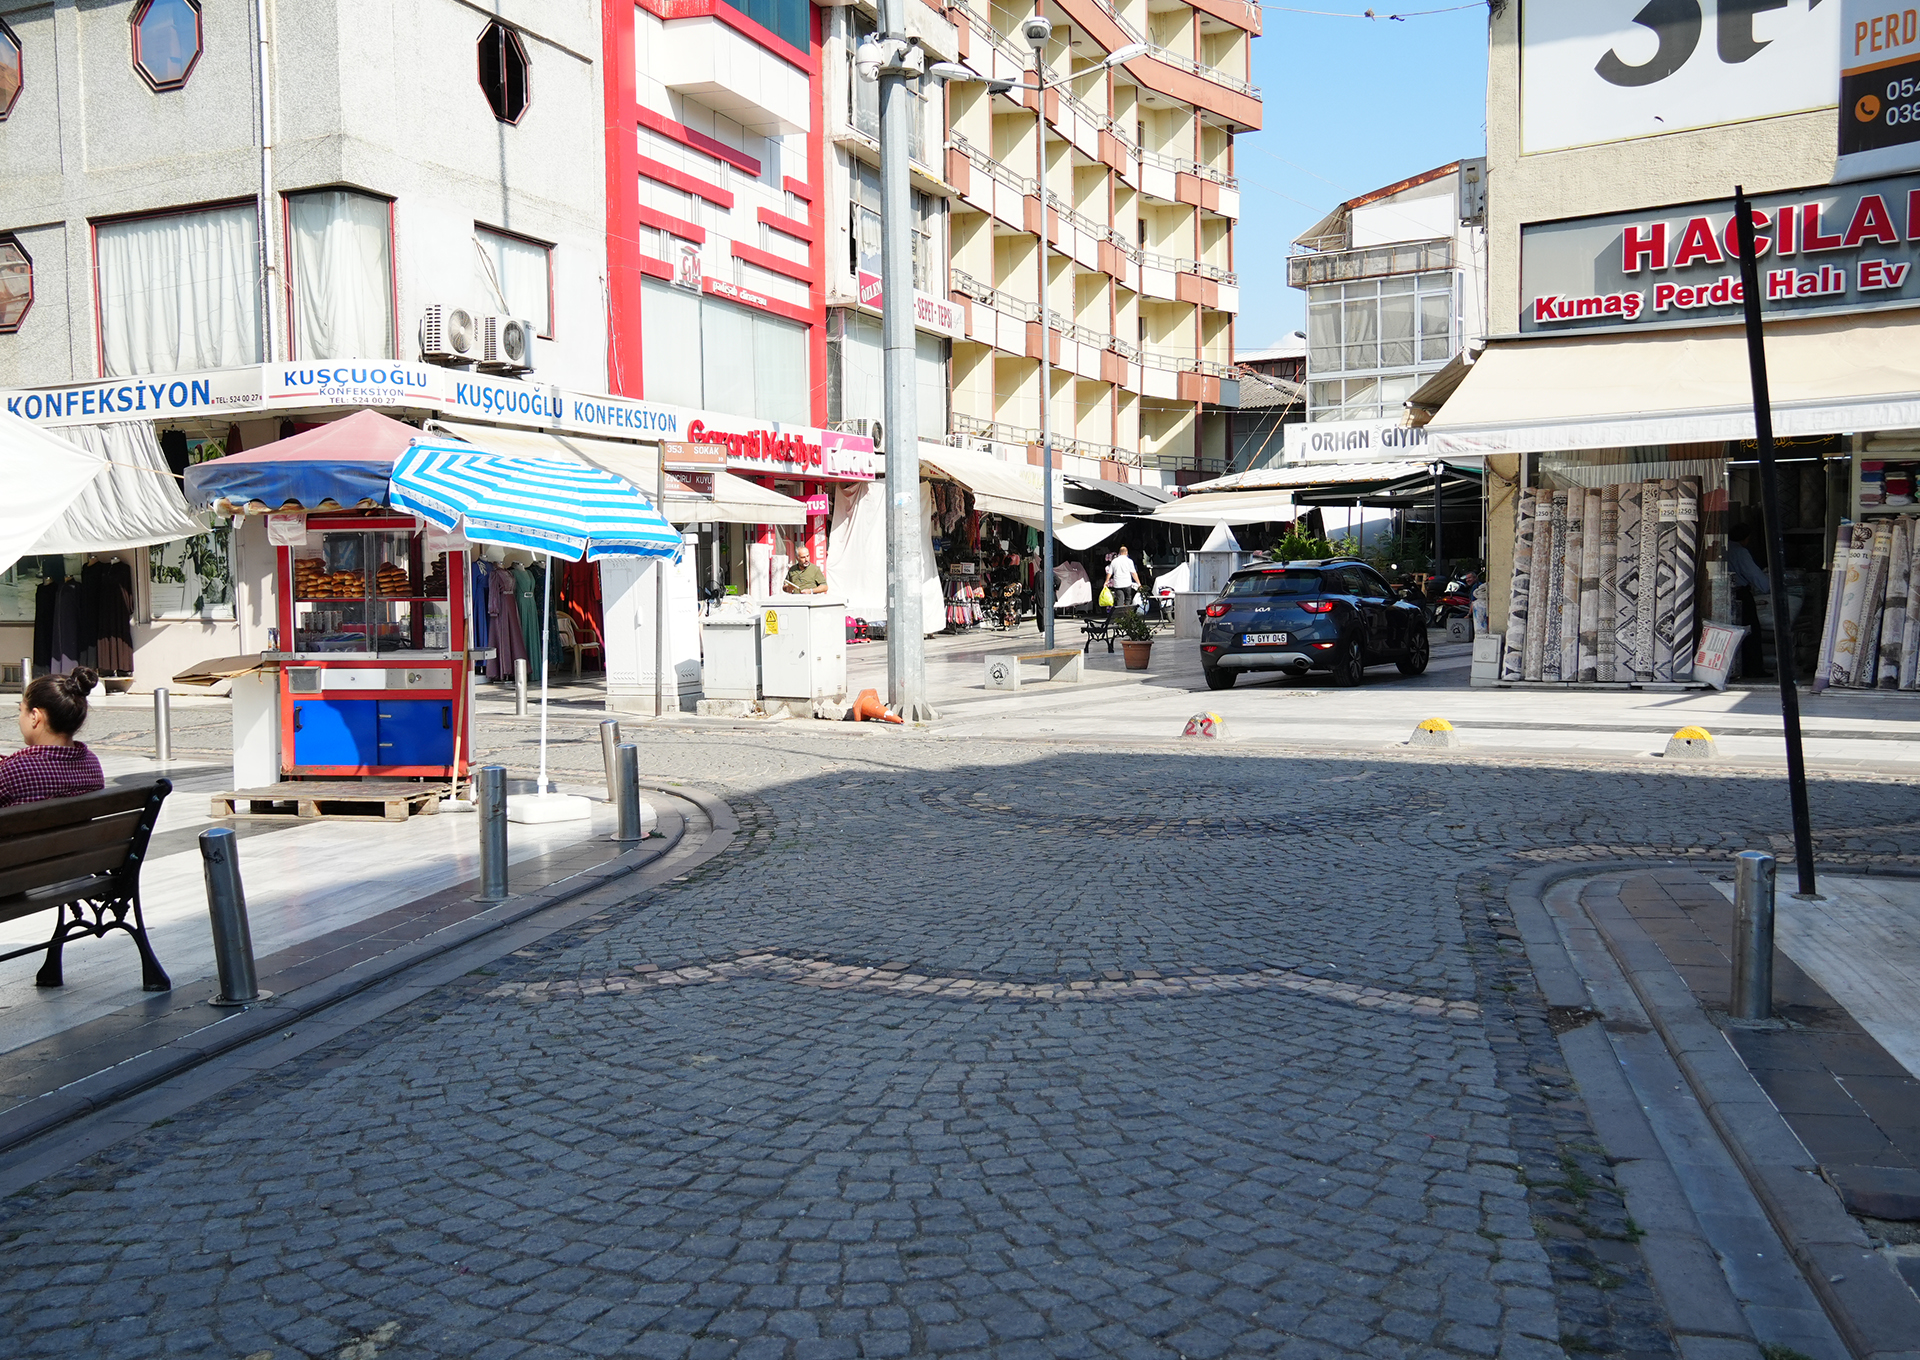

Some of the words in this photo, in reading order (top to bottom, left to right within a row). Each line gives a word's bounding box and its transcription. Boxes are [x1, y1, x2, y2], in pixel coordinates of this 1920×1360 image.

[1854, 8, 1920, 57] PERD
[1533, 290, 1645, 323] Kumaş
[1653, 275, 1745, 312] Perde
[1766, 264, 1846, 301] Halı
[1857, 258, 1911, 292] Ev
[917, 296, 934, 323] SEPET
[284, 364, 427, 388] KUŞÇUOĞLU
[7, 379, 210, 420] KONFEKSİYON
[319, 386, 404, 396] KONFEKSİYON
[456, 381, 563, 419] KUŞÇUOĞLU
[574, 401, 677, 433] KONFEKSİYON
[667, 444, 684, 454] 353.
[694, 446, 719, 455] SOKAK
[687, 419, 761, 459] Garanti
[761, 430, 822, 472] Mobilya
[1311, 429, 1369, 452] ORHAN
[696, 476, 712, 485] KUYU
[806, 500, 826, 511] TUS
[1246, 634, 1255, 643] 34
[1257, 634, 1270, 643] GYY
[1272, 633, 1286, 642] 046
